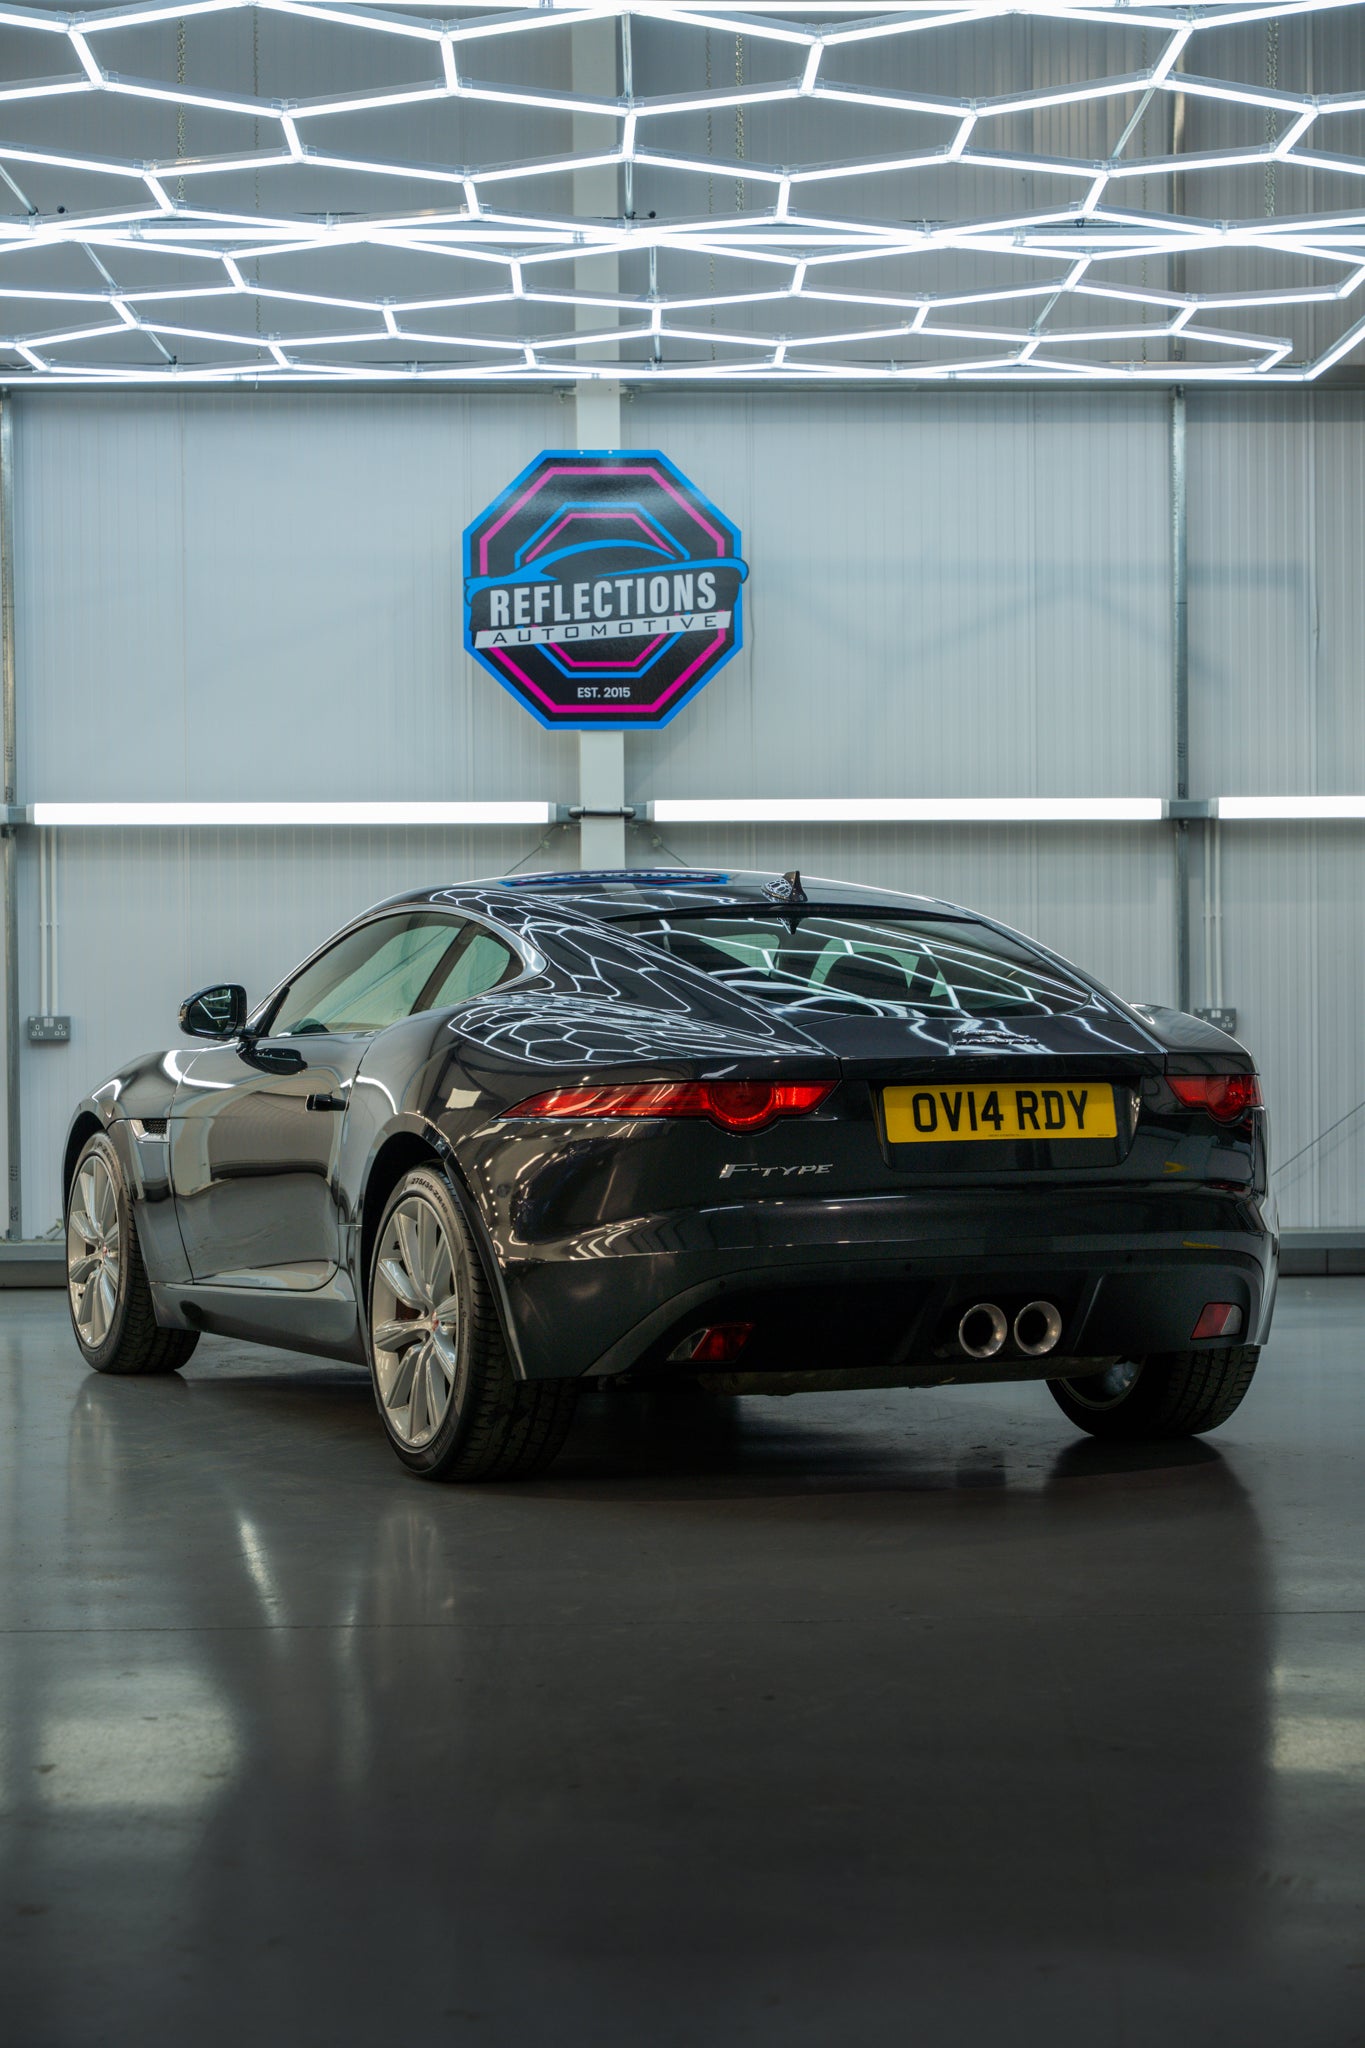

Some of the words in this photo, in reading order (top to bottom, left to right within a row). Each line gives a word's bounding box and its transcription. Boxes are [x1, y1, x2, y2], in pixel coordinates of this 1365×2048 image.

[489, 571, 717, 627] REFLECTIONS
[491, 615, 718, 646] AUTOMOTIVE
[577, 686, 601, 698] EST.
[603, 686, 631, 698] 2015
[911, 1090, 1004, 1133] OV14
[1016, 1089, 1089, 1131] RDY
[718, 1162, 834, 1179] F-TYPE
